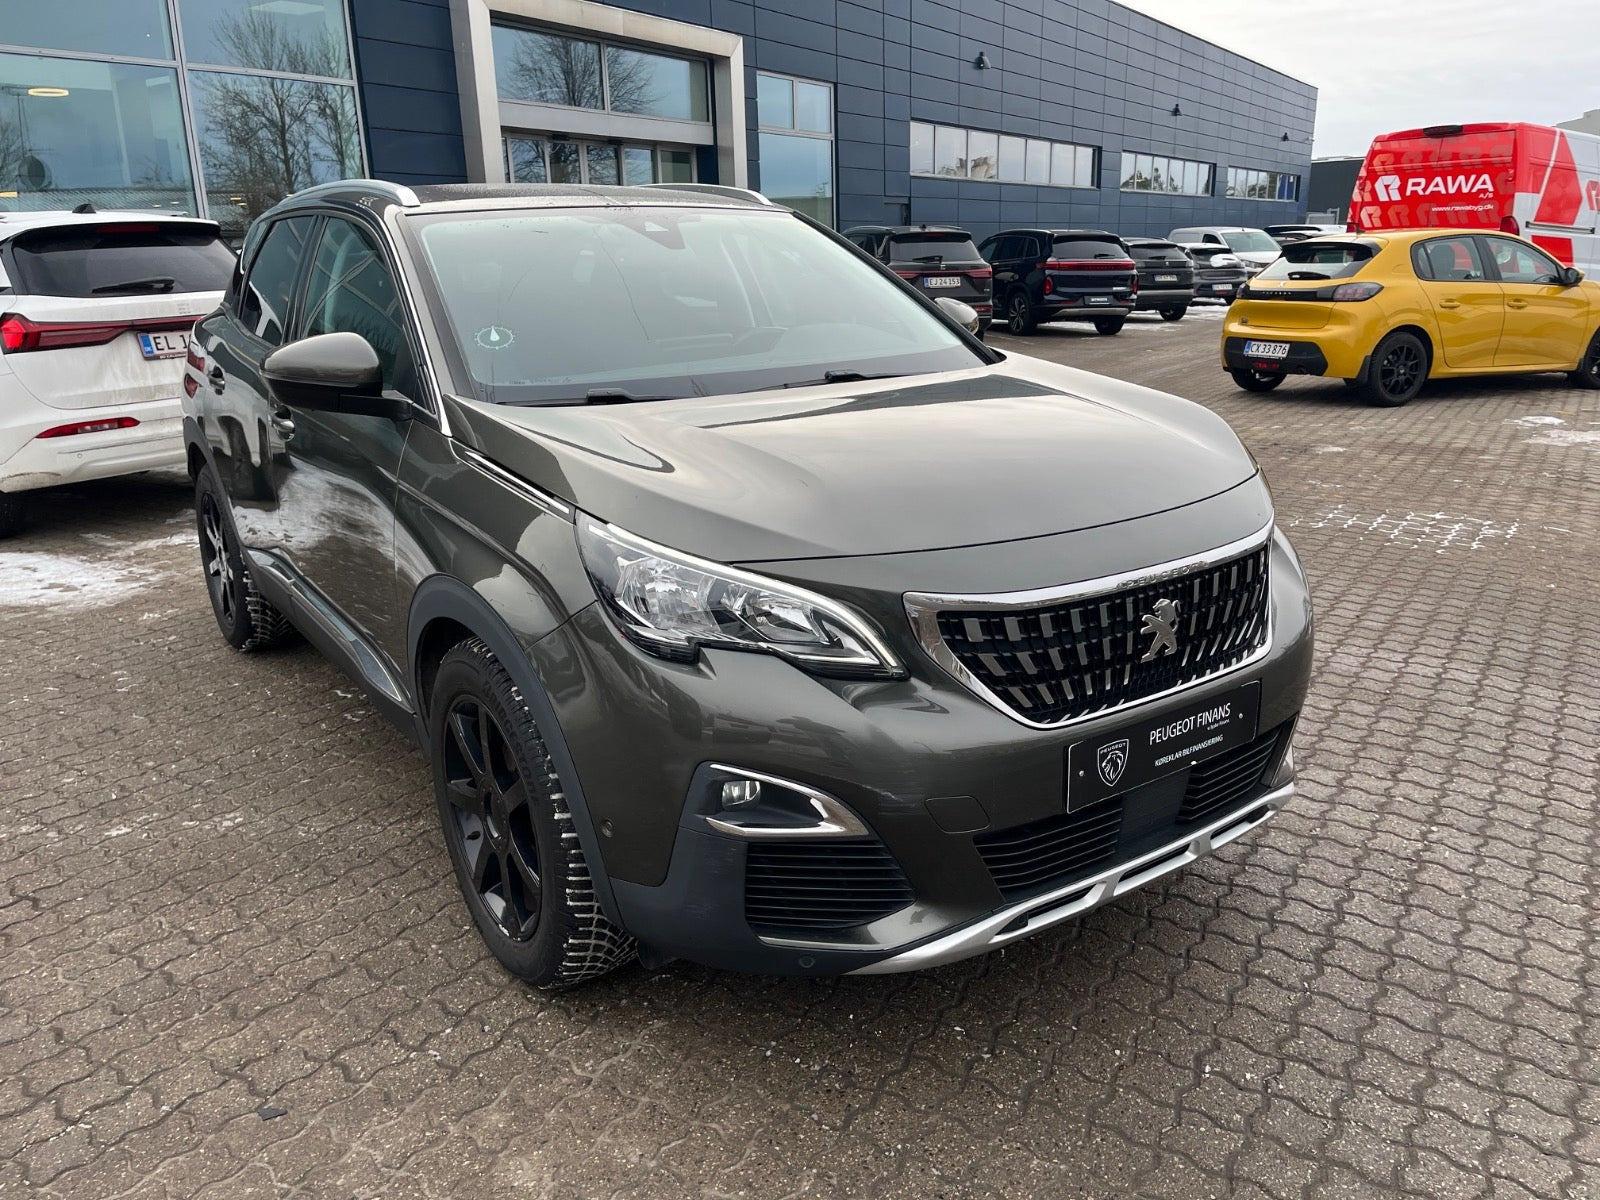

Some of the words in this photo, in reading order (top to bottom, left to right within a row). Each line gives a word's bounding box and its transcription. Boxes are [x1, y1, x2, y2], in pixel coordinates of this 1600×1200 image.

[1405, 173, 1495, 197] RAWA
[1431, 203, 1494, 212] www.rawabyg.dk
[152, 335, 176, 351] EL
[1250, 343, 1261, 353] CX
[1261, 344, 1271, 354] 33
[1271, 344, 1287, 355] 876
[1149, 715, 1196, 746] PEUGEOT
[1196, 702, 1231, 728] FINANS
[1099, 742, 1127, 754] PEUGEOT
